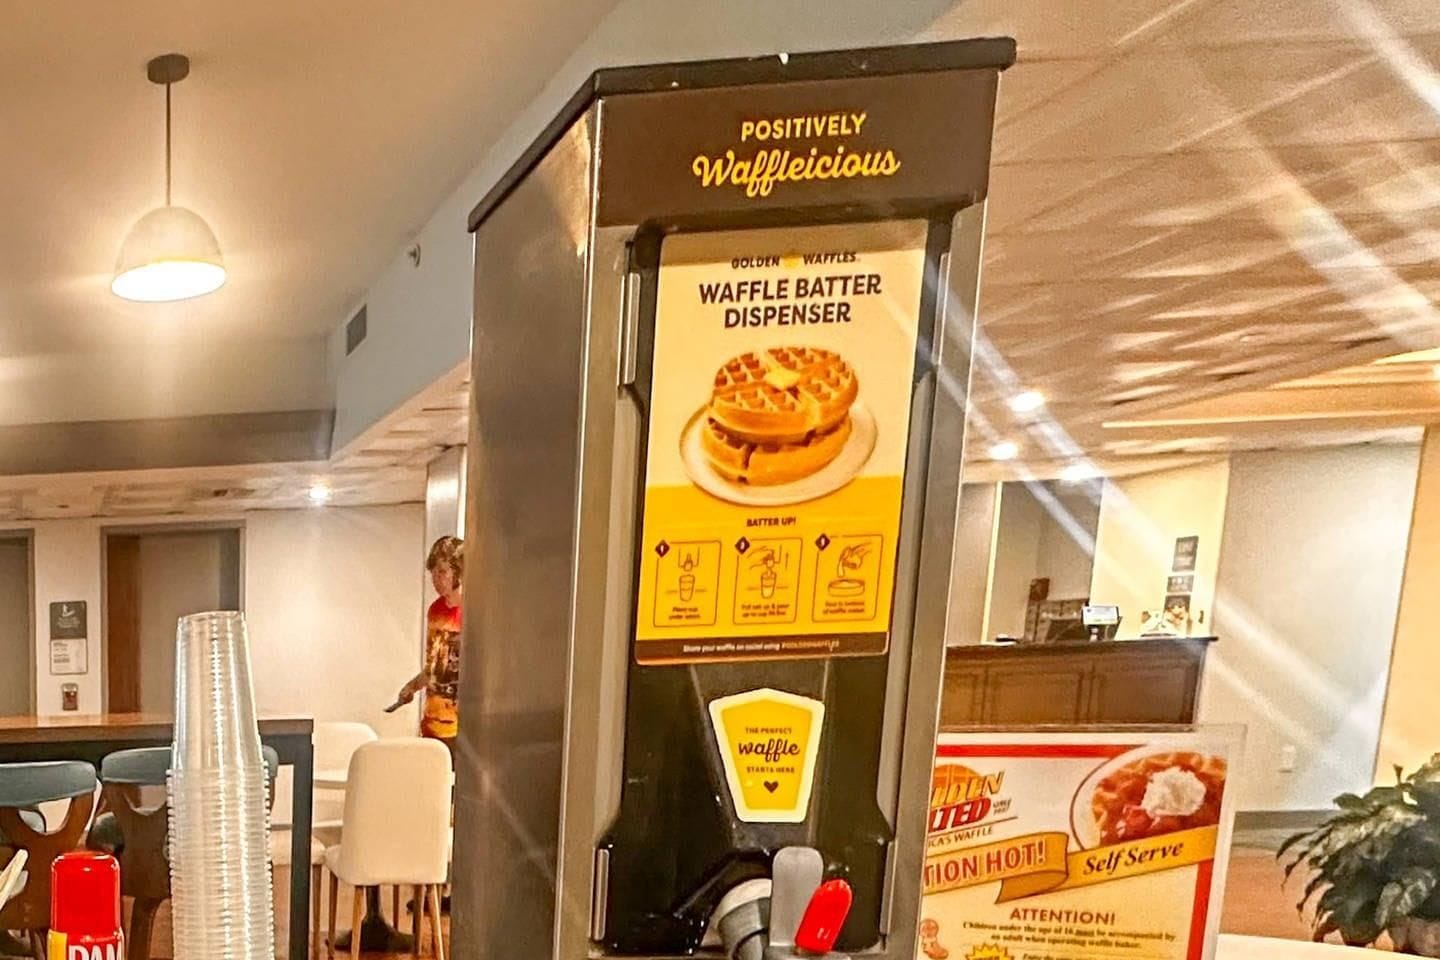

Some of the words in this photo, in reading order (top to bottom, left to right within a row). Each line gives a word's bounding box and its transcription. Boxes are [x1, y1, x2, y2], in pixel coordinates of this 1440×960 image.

[741, 112, 867, 141] POSITIVELY
[691, 145, 902, 197] Waffleicious
[731, 255, 780, 269] GOLDEN
[802, 251, 857, 265] WAFFLES
[698, 278, 790, 304] WAFFLE
[794, 273, 882, 298] BATTER
[723, 302, 852, 328] DISPENSER
[746, 517, 780, 527] BATTER
[781, 516, 796, 526] UP!
[738, 738, 800, 762] waffle
[928, 795, 991, 833] LTED
[954, 826, 993, 843] WAFFLE
[924, 855, 978, 887] TION
[986, 840, 1044, 874] HOT!
[1082, 851, 1122, 876] Self
[1123, 841, 1185, 867] Serve
[1010, 908, 1115, 926] ATTENTION!
